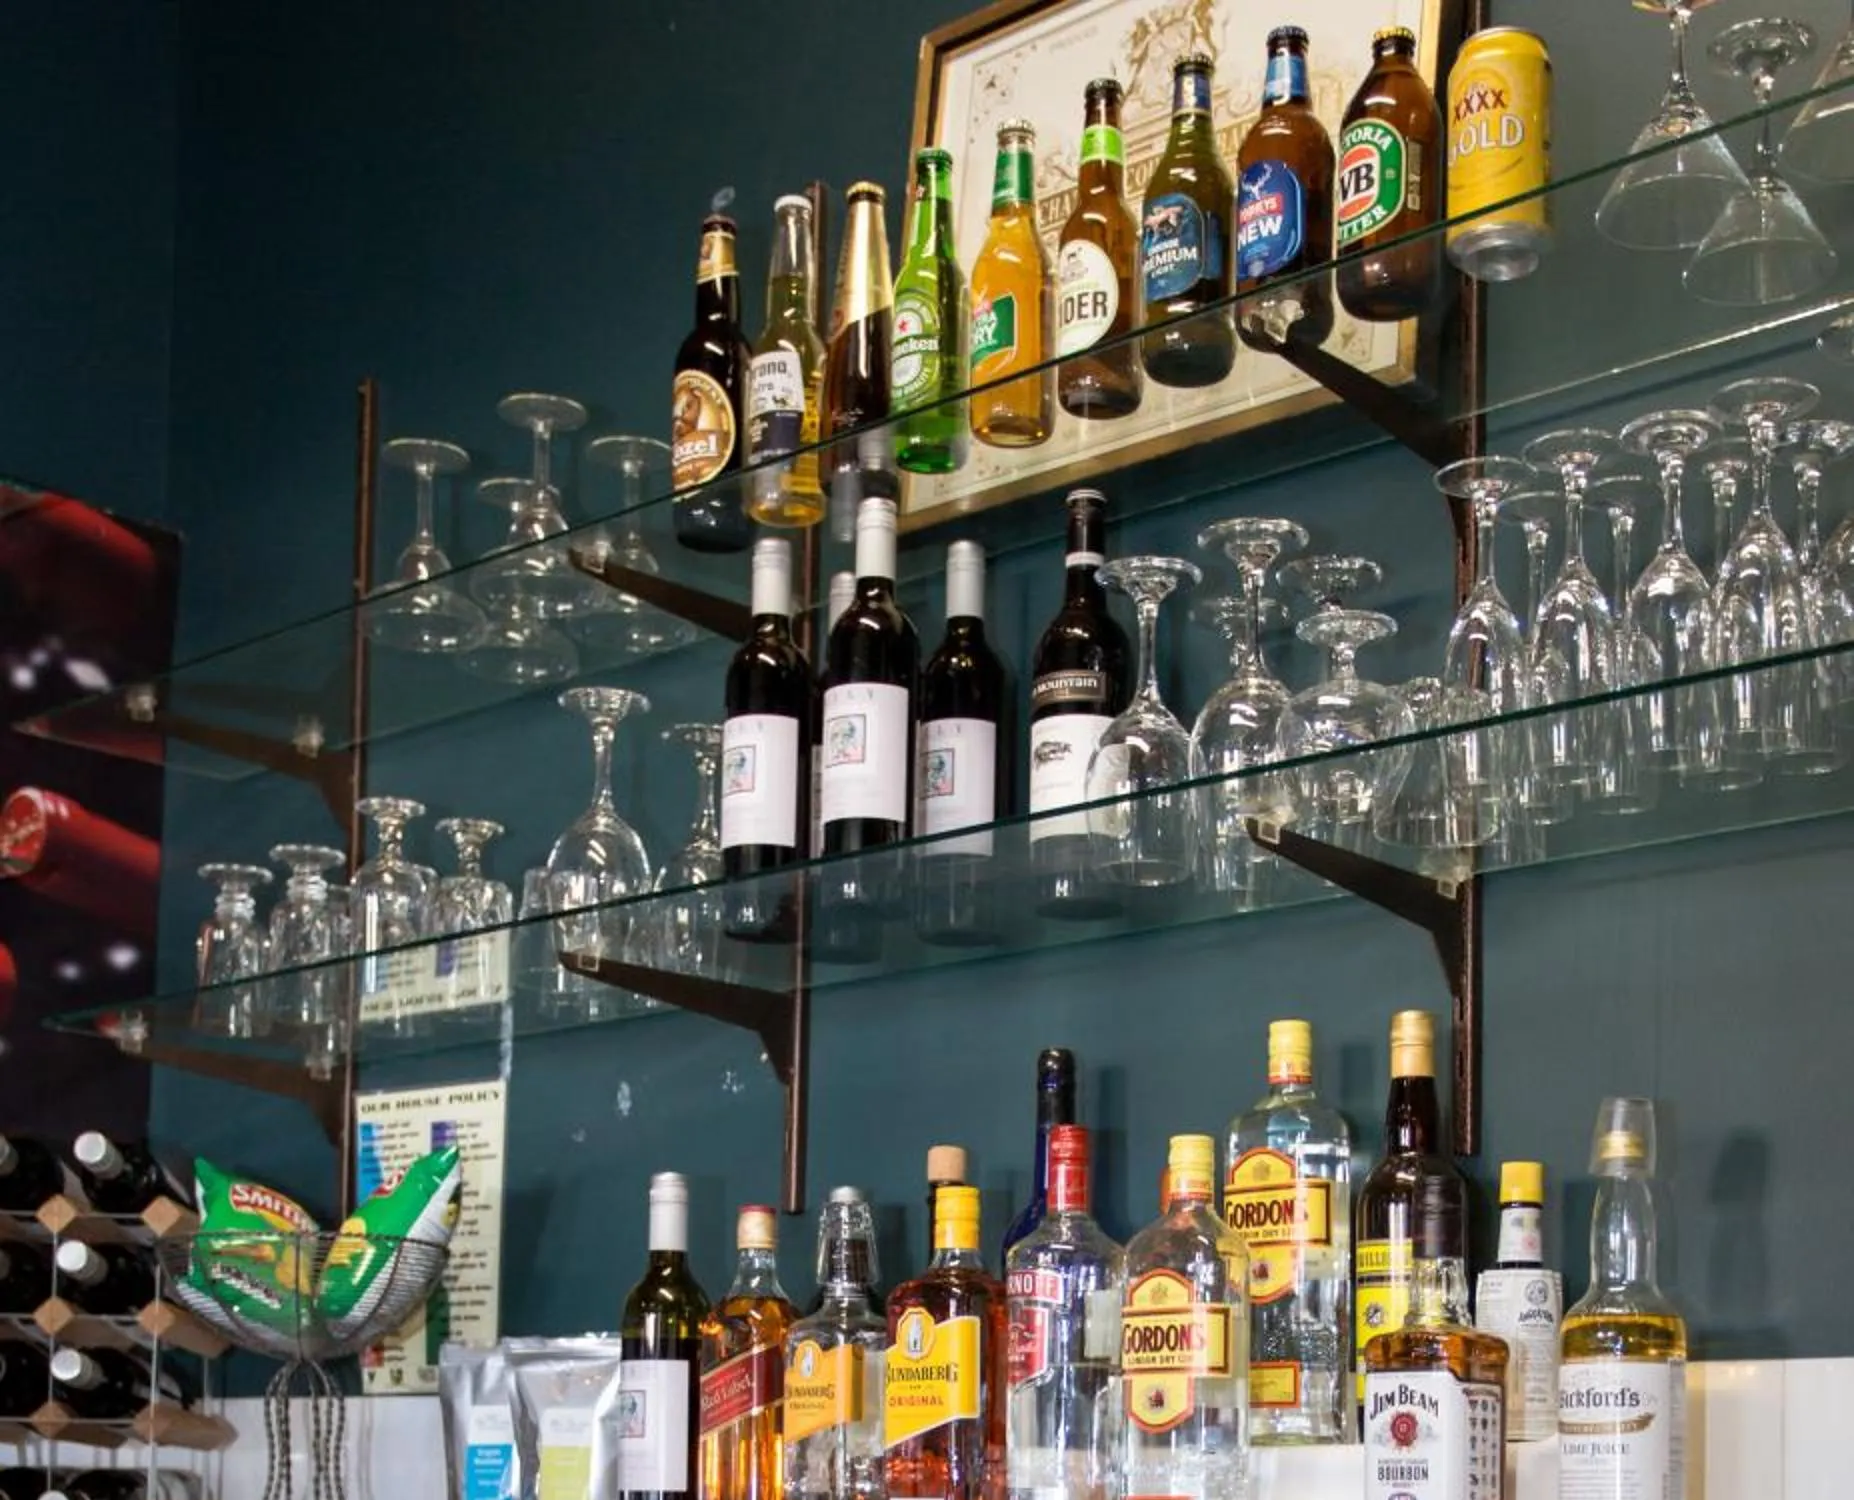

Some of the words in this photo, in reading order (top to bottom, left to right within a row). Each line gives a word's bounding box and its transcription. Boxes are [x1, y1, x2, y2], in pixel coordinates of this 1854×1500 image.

[1343, 126, 1394, 150] TORIA
[1340, 163, 1375, 198] VB
[1237, 215, 1284, 252] NEW
[1338, 205, 1388, 241] ITTER
[1143, 245, 1198, 274] EMIUM
[1058, 290, 1108, 328] IDER
[1370, 1390, 1396, 1420] JIM
[1398, 1383, 1439, 1418] BEAM
[1377, 1465, 1429, 1481] BOURBON
